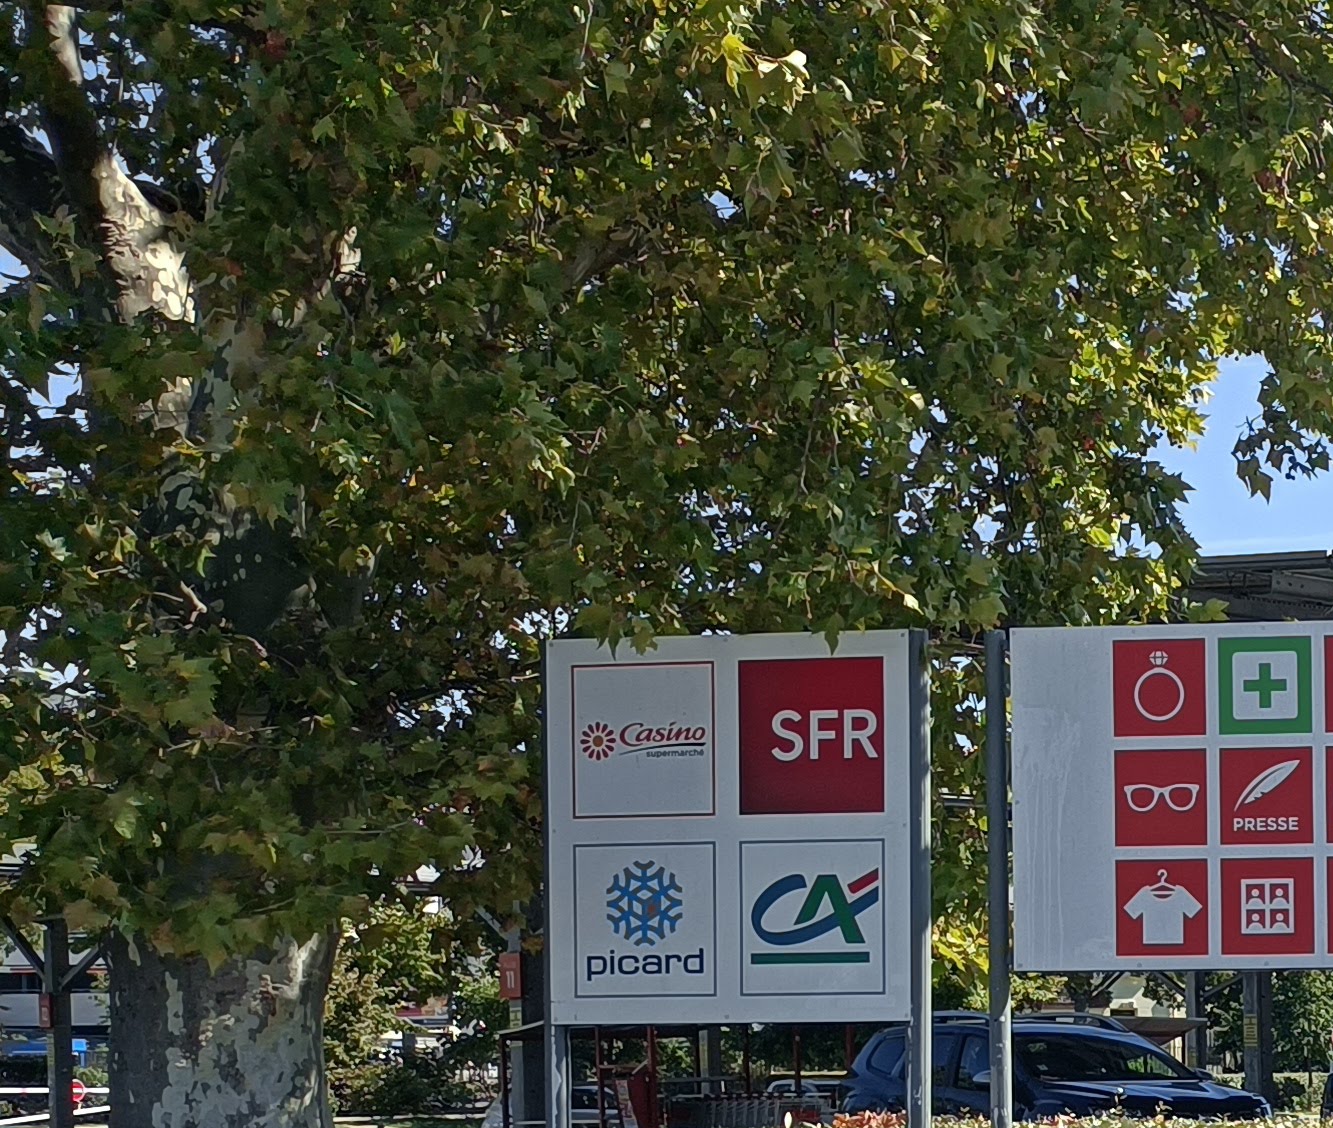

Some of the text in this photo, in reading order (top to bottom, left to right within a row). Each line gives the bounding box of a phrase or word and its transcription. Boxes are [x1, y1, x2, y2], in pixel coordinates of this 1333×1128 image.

[619, 721, 706, 747] Casino
[771, 708, 879, 762] SFR
[646, 748, 705, 758] supermarché
[1233, 816, 1299, 832] PRESSE
[586, 947, 705, 982] picard
